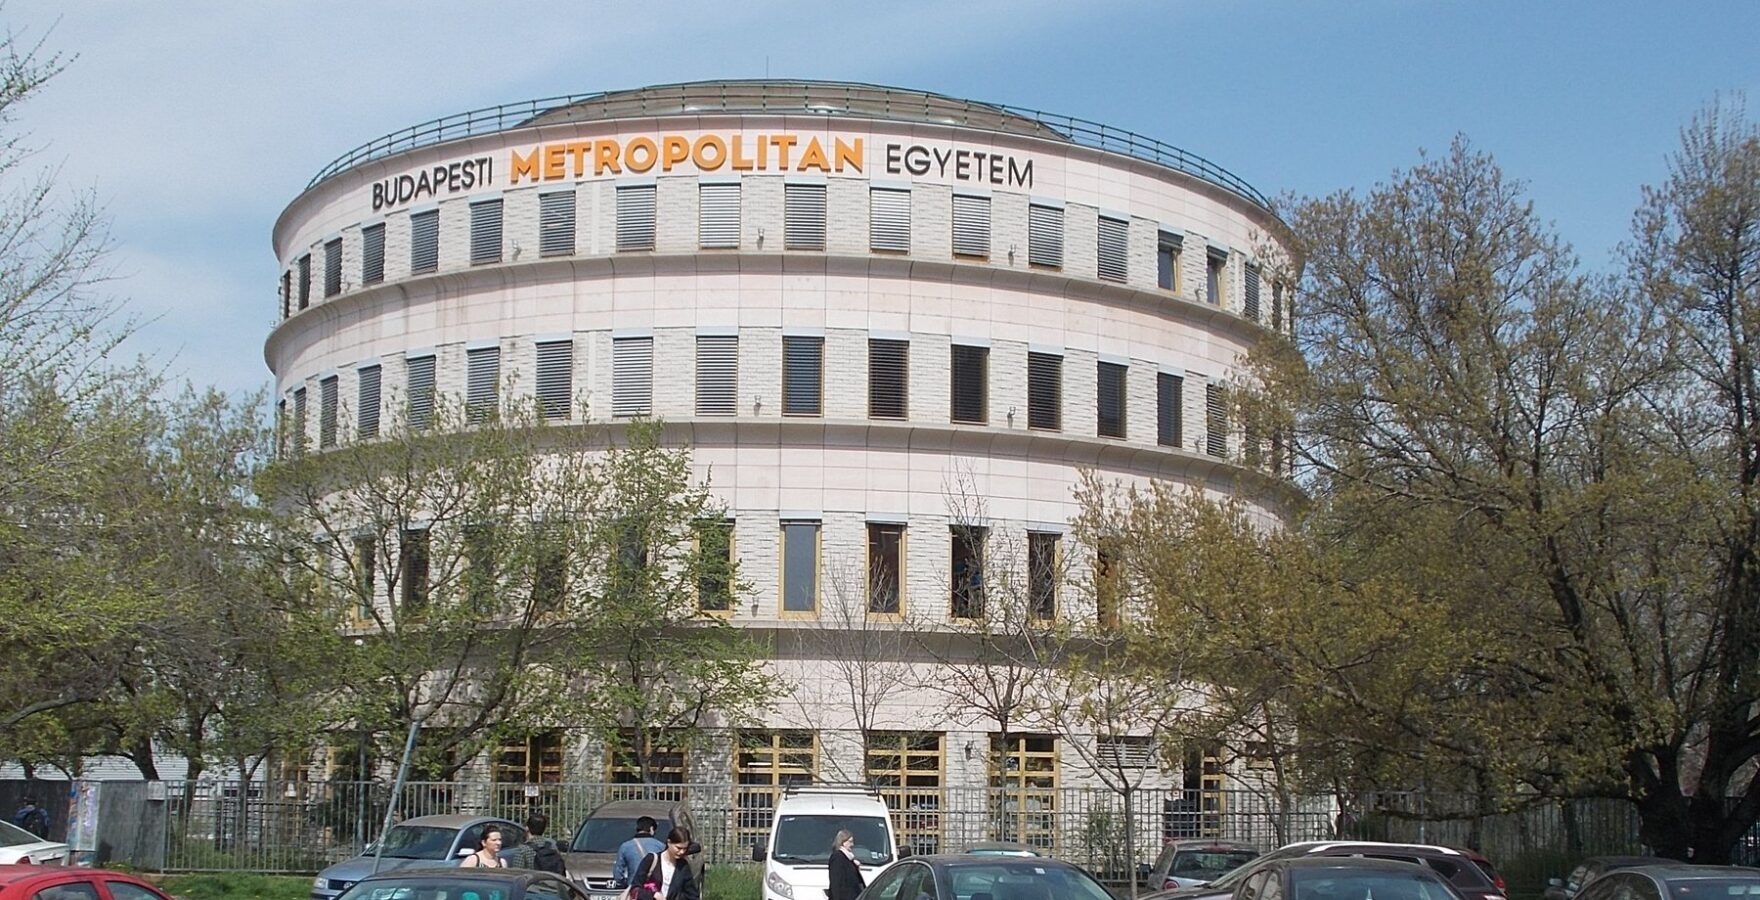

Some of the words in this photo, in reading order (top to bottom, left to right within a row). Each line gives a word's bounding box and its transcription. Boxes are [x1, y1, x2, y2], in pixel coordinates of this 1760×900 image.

[373, 157, 493, 210] BUDAPESTI
[511, 135, 864, 183] METROPOLITAN
[886, 144, 1034, 188] EGYETEM
